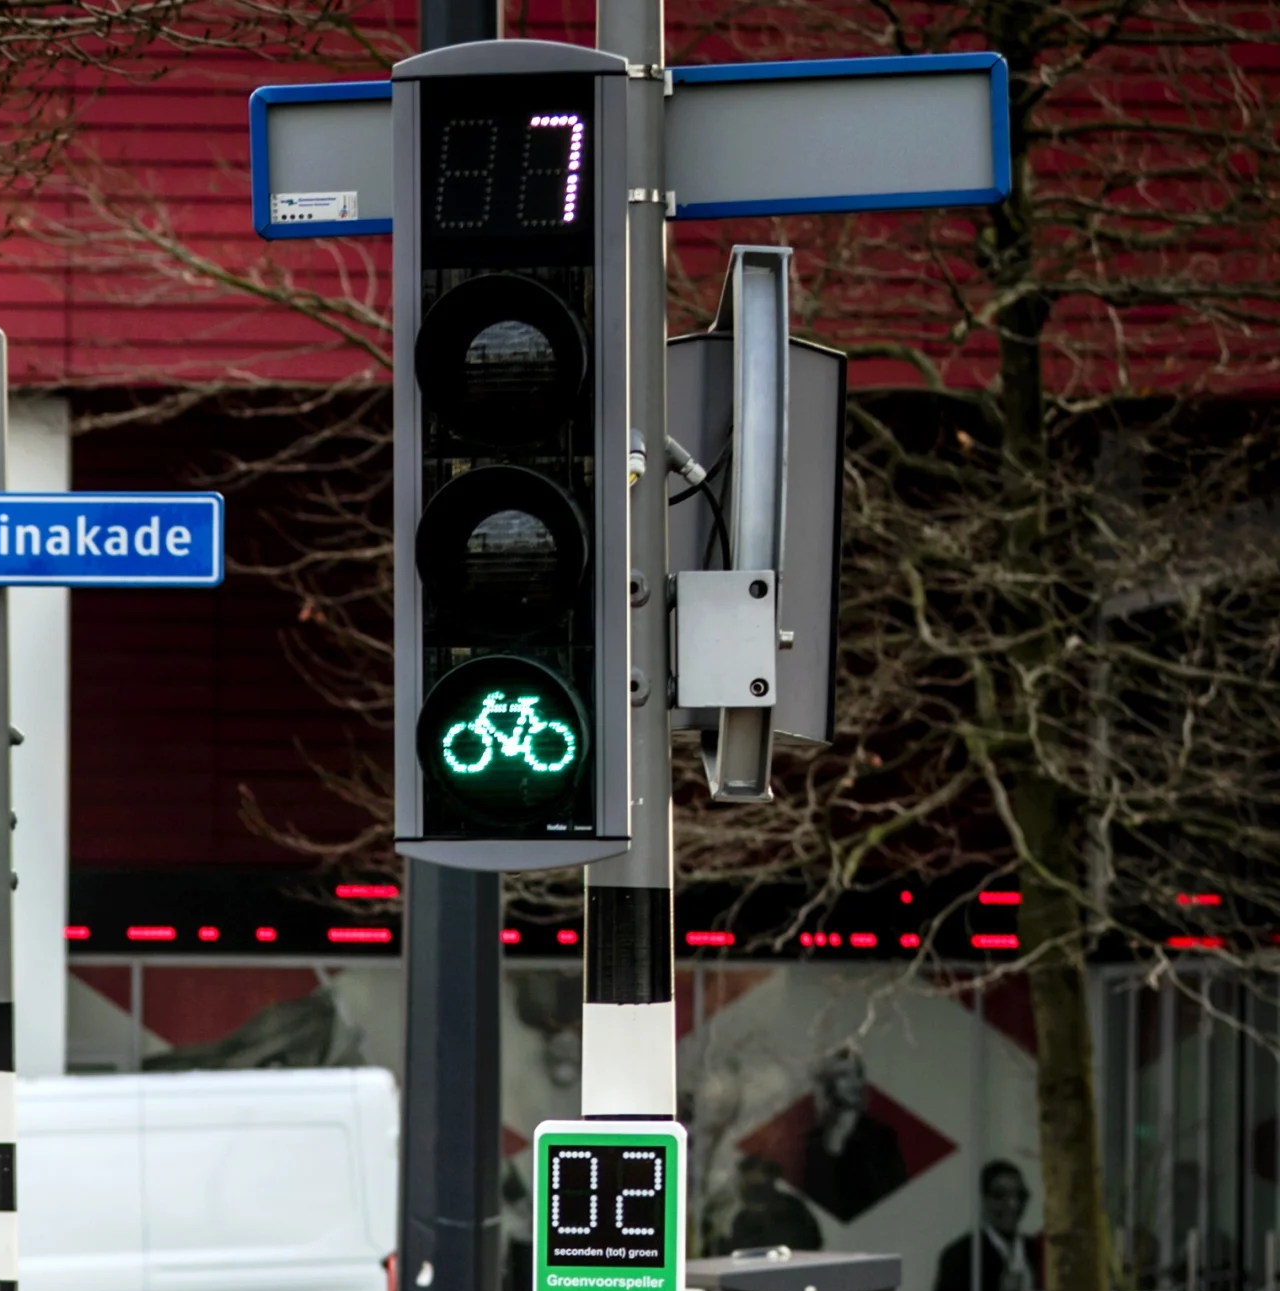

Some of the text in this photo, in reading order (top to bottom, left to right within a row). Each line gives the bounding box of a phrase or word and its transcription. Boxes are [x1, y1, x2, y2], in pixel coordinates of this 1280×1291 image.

[530, 115, 584, 222] 7
[551, 1150, 663, 1235] 02
[554, 1247, 658, 1259] seconden (tot) groen
[546, 1273, 665, 1290] Groenvoorspeller
